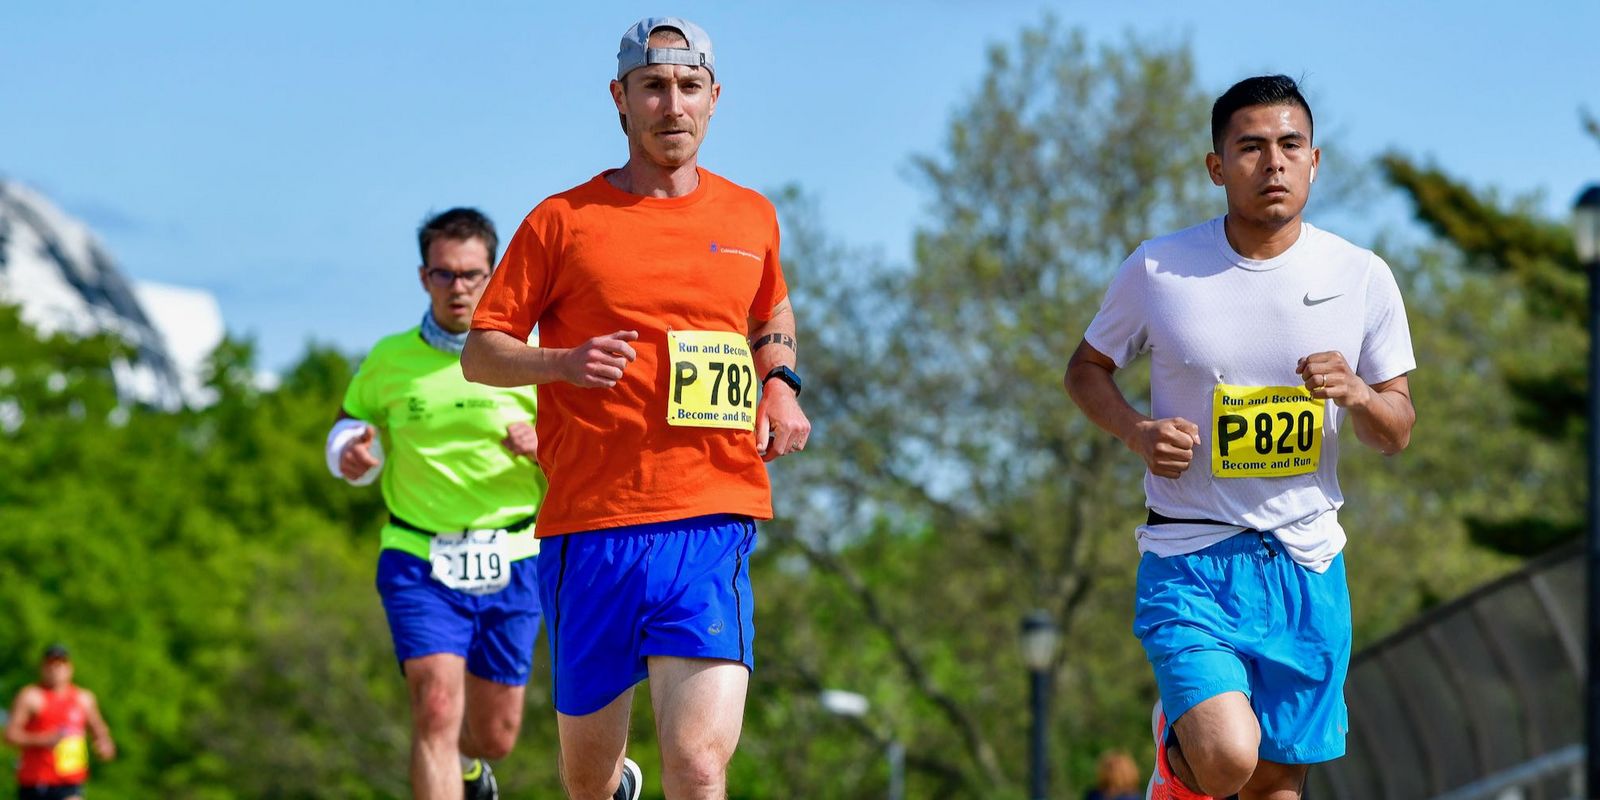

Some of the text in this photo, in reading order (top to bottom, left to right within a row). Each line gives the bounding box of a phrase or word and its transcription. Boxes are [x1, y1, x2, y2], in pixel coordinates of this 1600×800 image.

[678, 342, 748, 357] Run and Becom
[674, 361, 752, 408] P 782
[1222, 395, 1244, 406] Run
[1248, 396, 1268, 405] and
[677, 408, 719, 420] Become
[722, 411, 739, 421] and
[1218, 410, 1314, 457] P 820
[1222, 457, 1311, 470] Become and Run
[459, 551, 502, 580] 119
